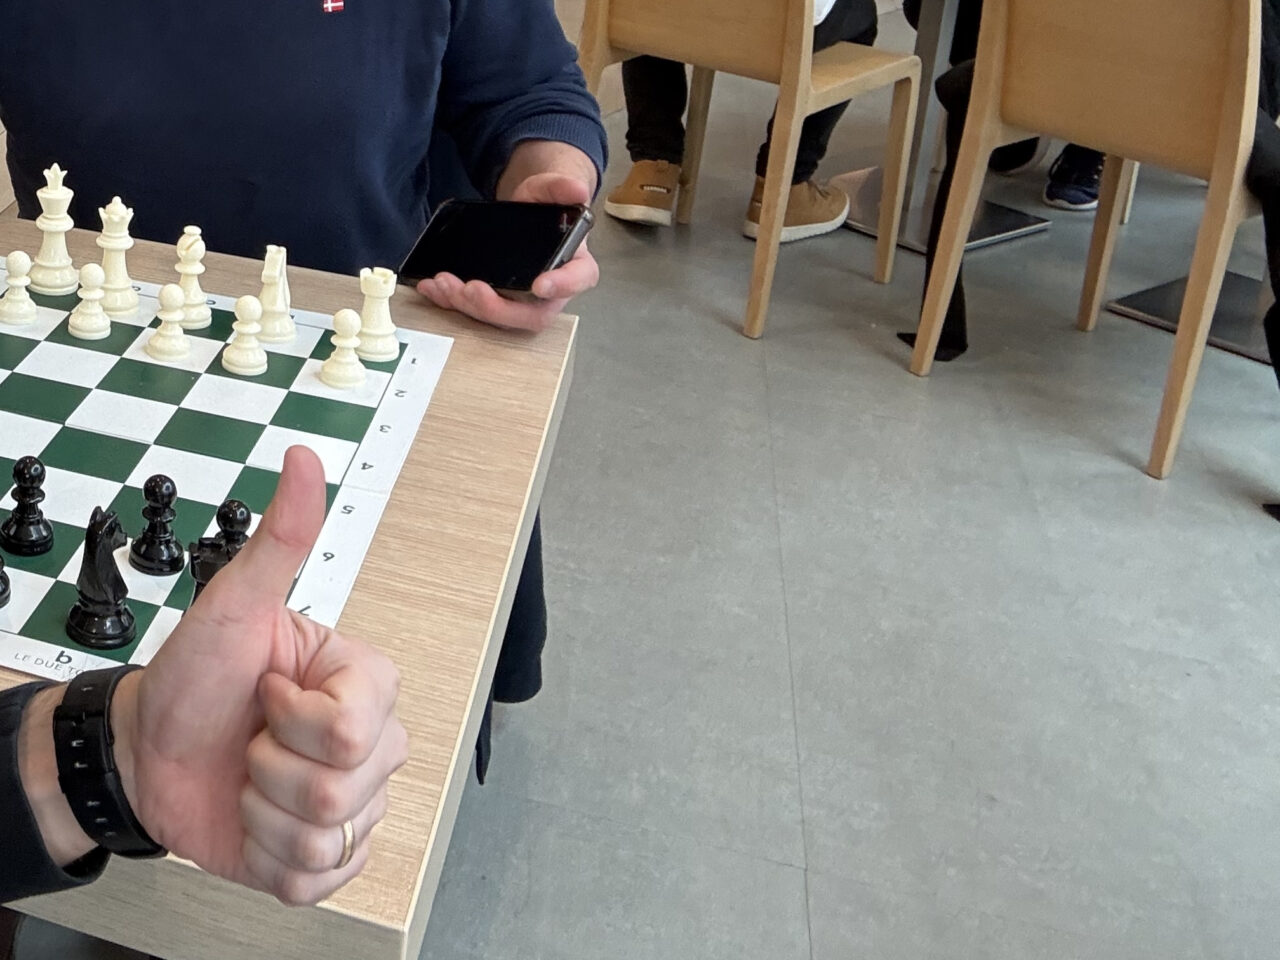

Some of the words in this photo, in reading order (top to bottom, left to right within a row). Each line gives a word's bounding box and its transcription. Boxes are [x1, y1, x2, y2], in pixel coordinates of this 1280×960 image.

[394, 389, 408, 399] 2
[379, 424, 392, 434] 3
[360, 461, 374, 471] 4
[340, 504, 356, 515] 5
[322, 551, 335, 562] 6
[54, 650, 73, 665] b
[33, 657, 63, 671] DUE
